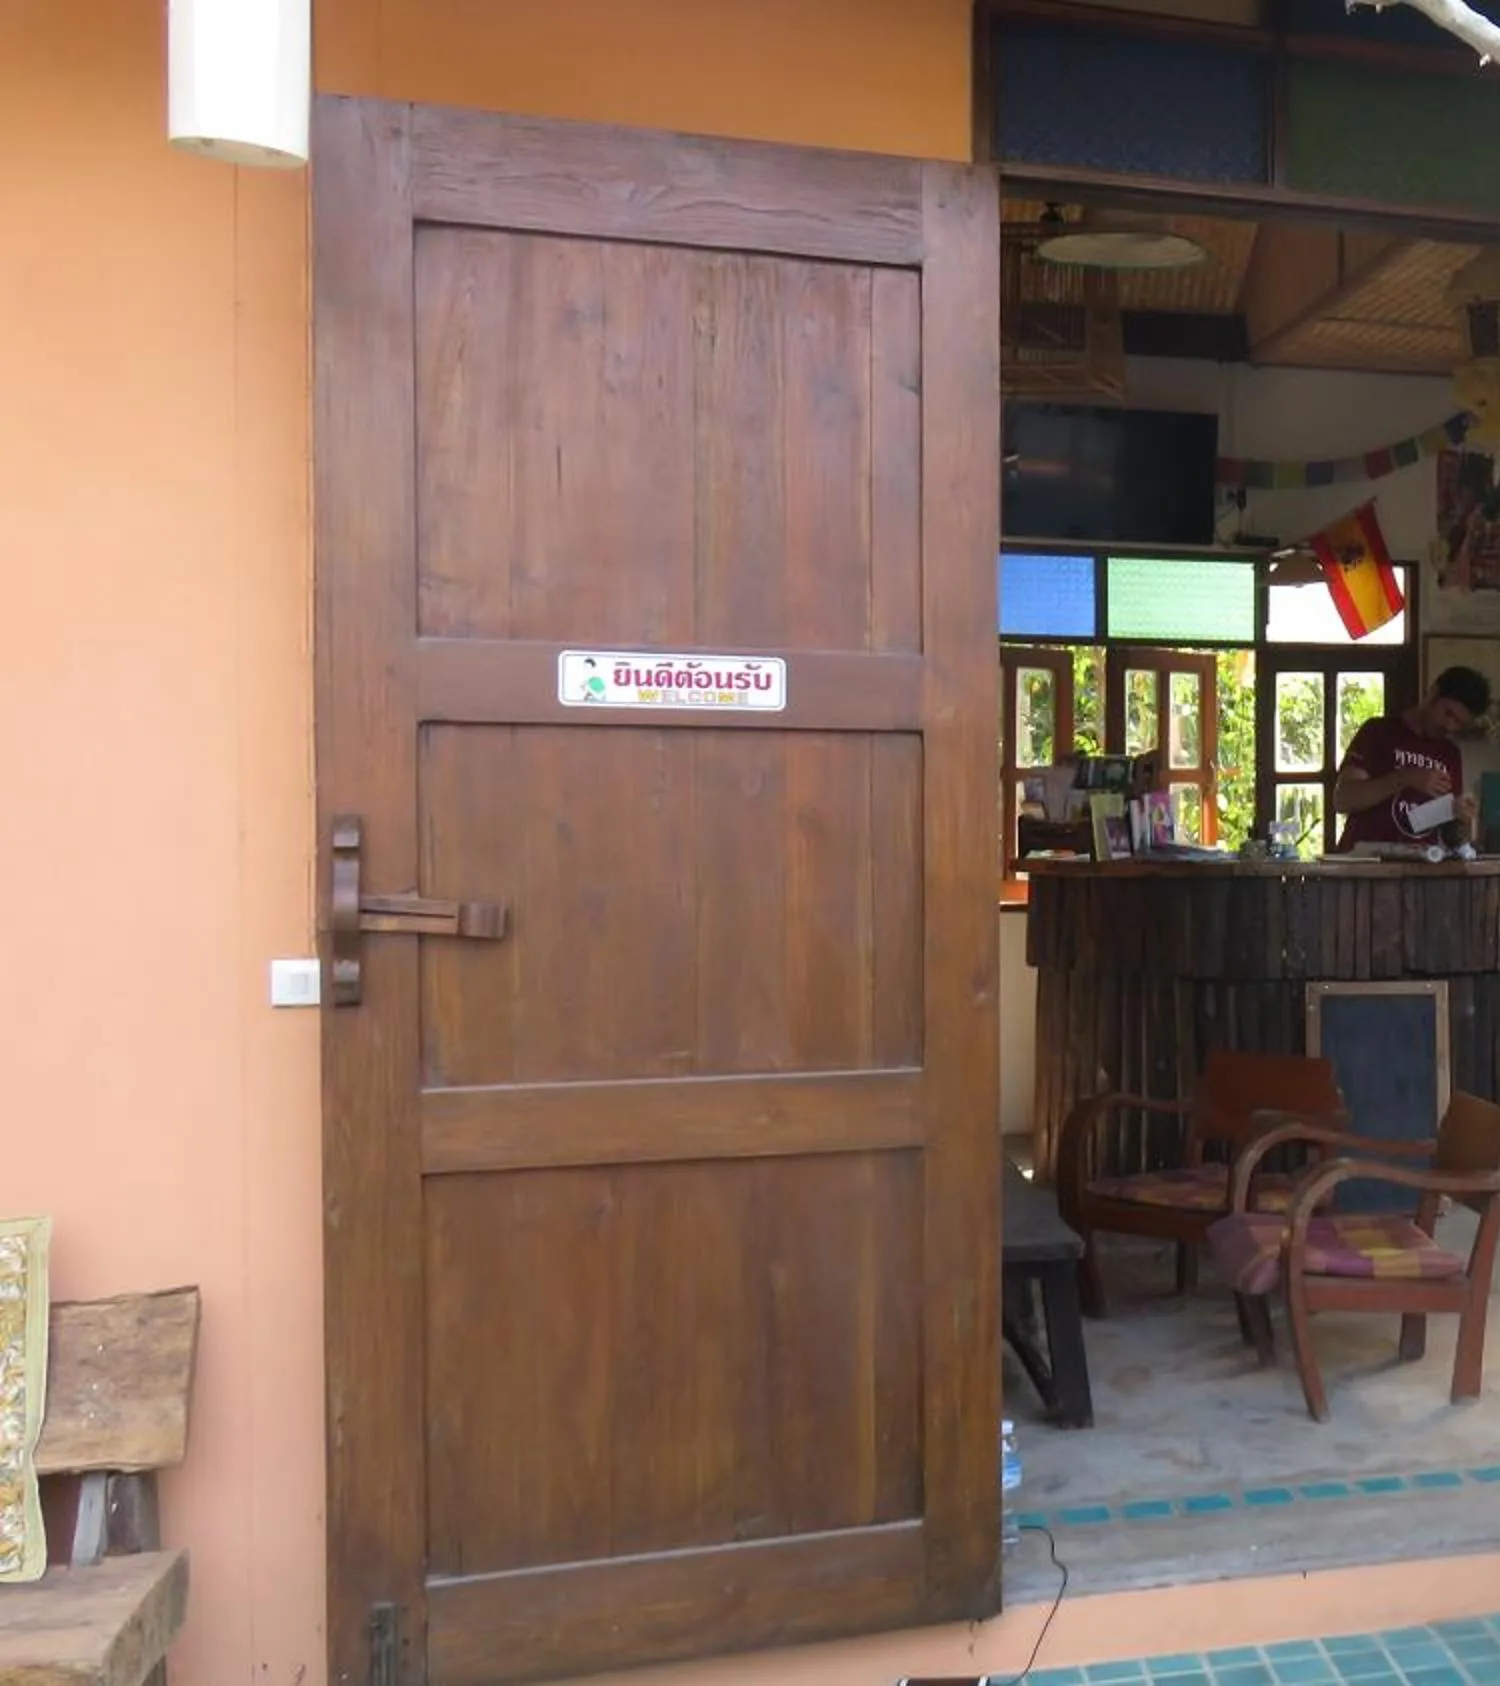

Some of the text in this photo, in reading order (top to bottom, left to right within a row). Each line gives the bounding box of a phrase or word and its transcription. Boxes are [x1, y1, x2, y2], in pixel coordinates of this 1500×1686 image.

[613, 661, 773, 691] ยินดีต้อนรับ
[637, 689, 749, 704] WELCOME
